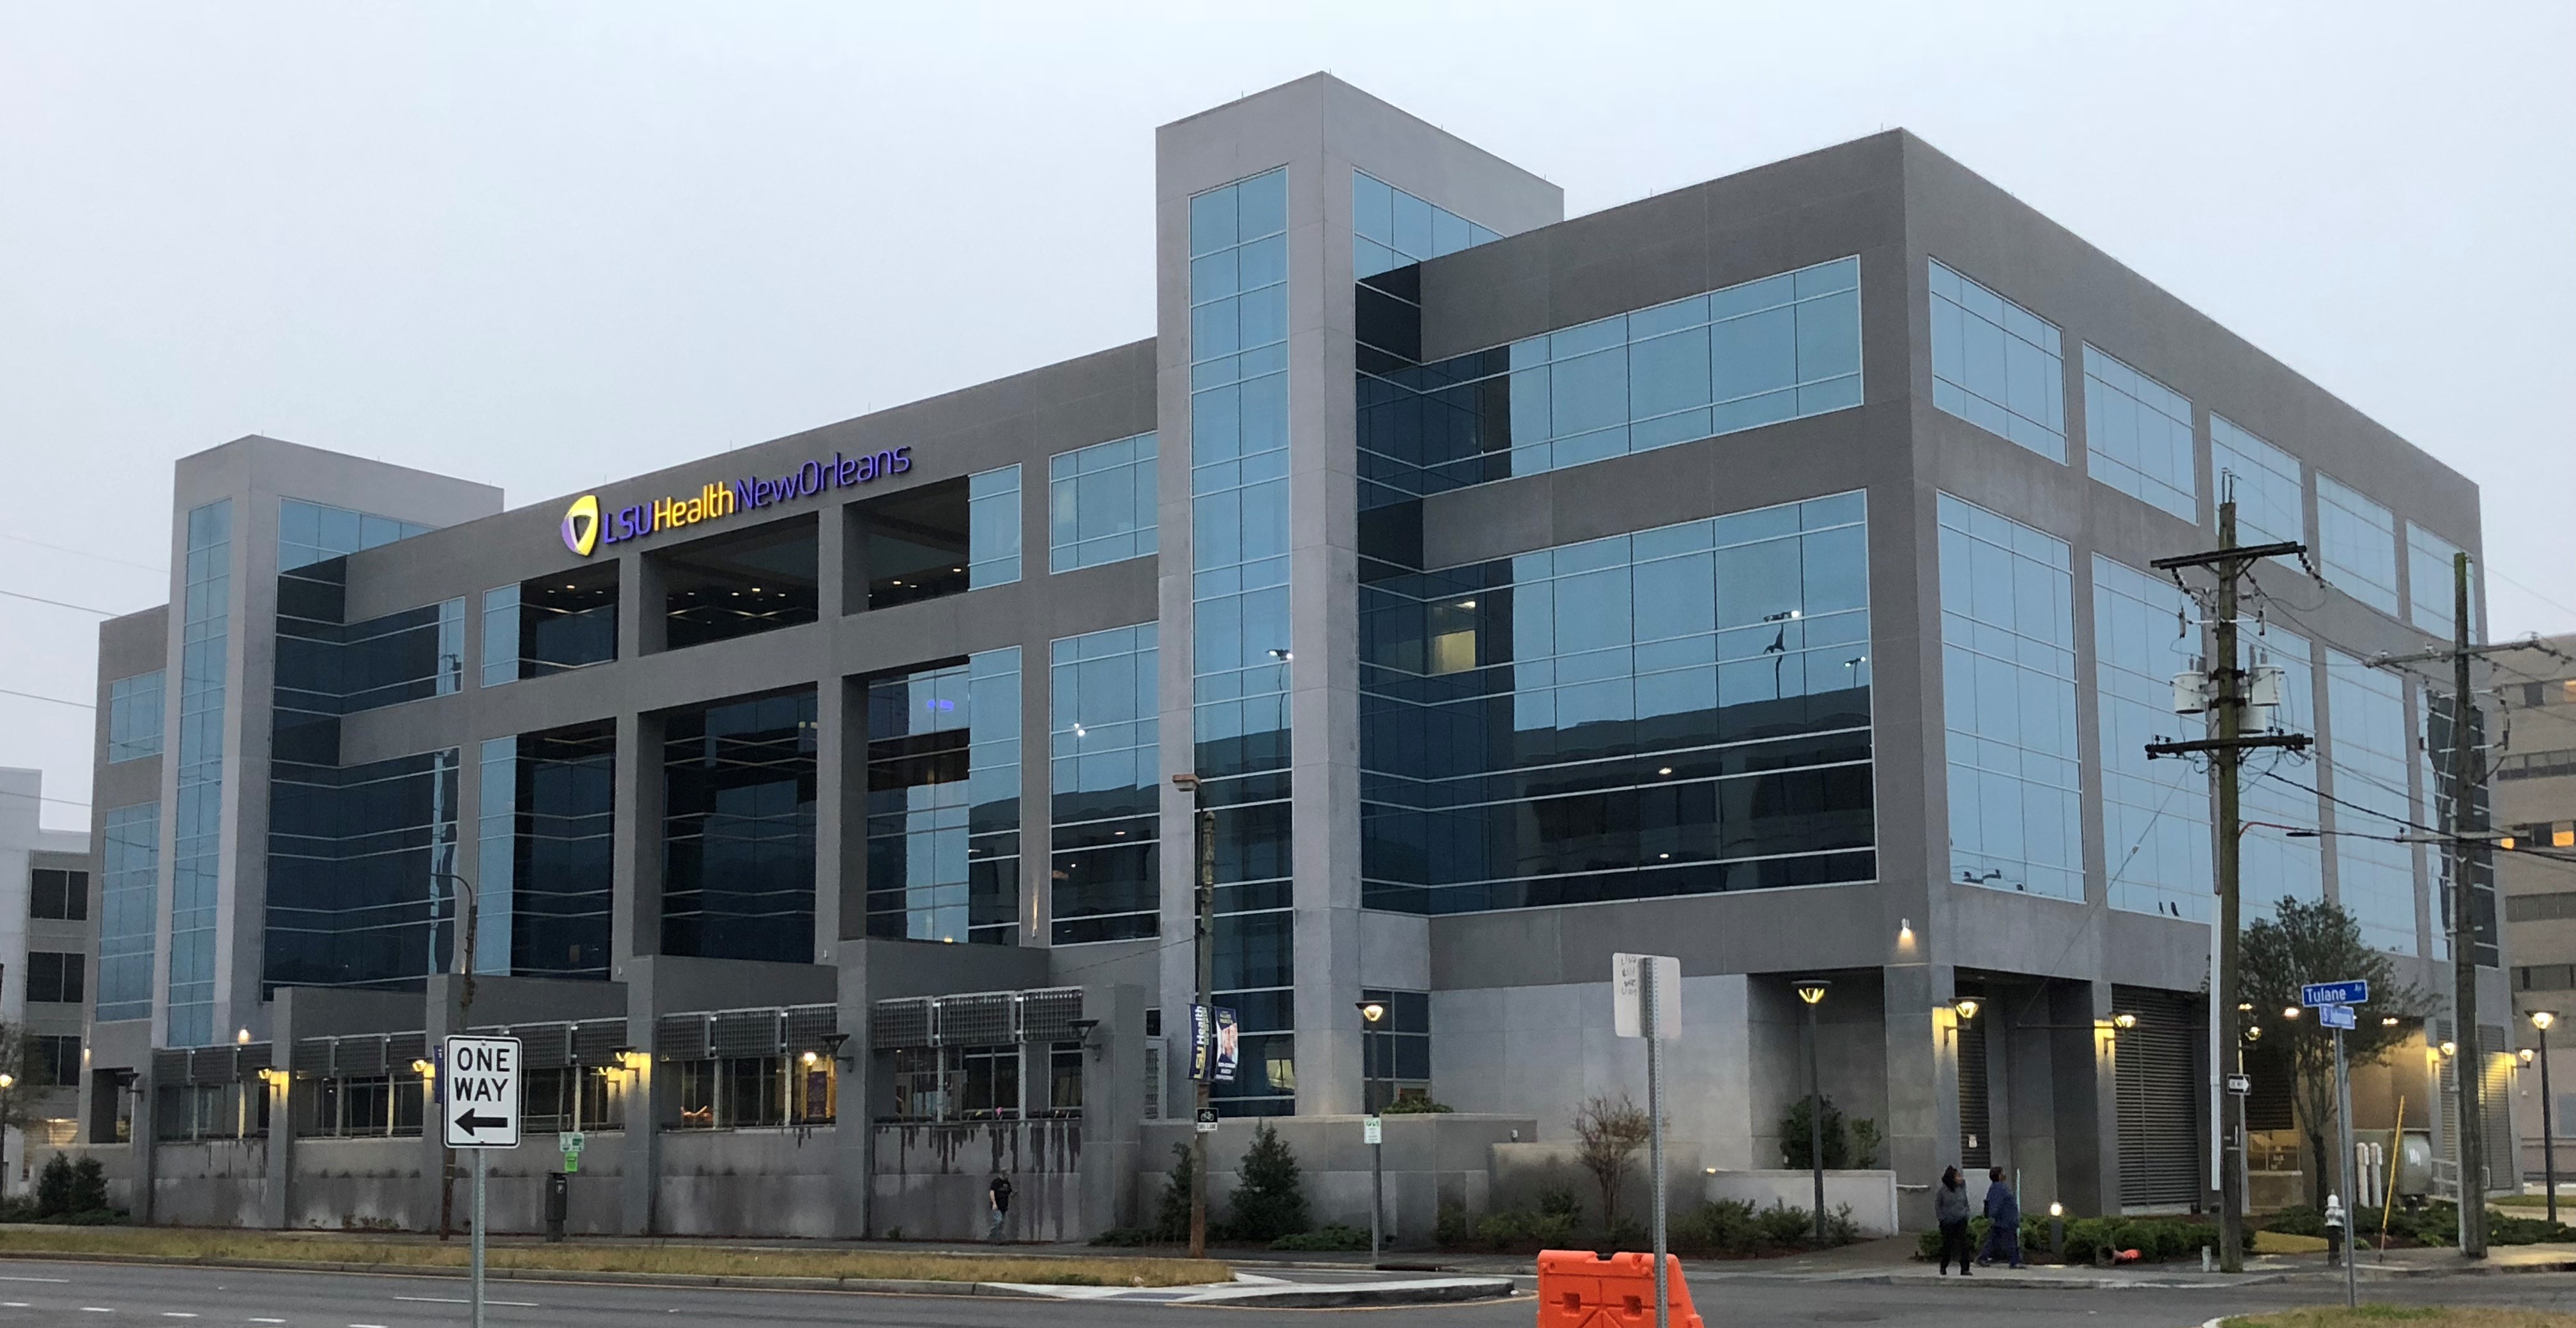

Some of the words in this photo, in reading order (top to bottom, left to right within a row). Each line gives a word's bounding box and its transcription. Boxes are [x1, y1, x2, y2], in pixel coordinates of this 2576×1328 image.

[603, 445, 912, 543] LSUHealthNewOrleans
[2306, 987, 2347, 1003] Tulane
[1195, 1006, 1204, 1044] Health
[2323, 1007, 2328, 1022] S
[457, 1047, 510, 1072] ONE
[1193, 1046, 1204, 1079] LSU
[454, 1077, 509, 1102] WAY
